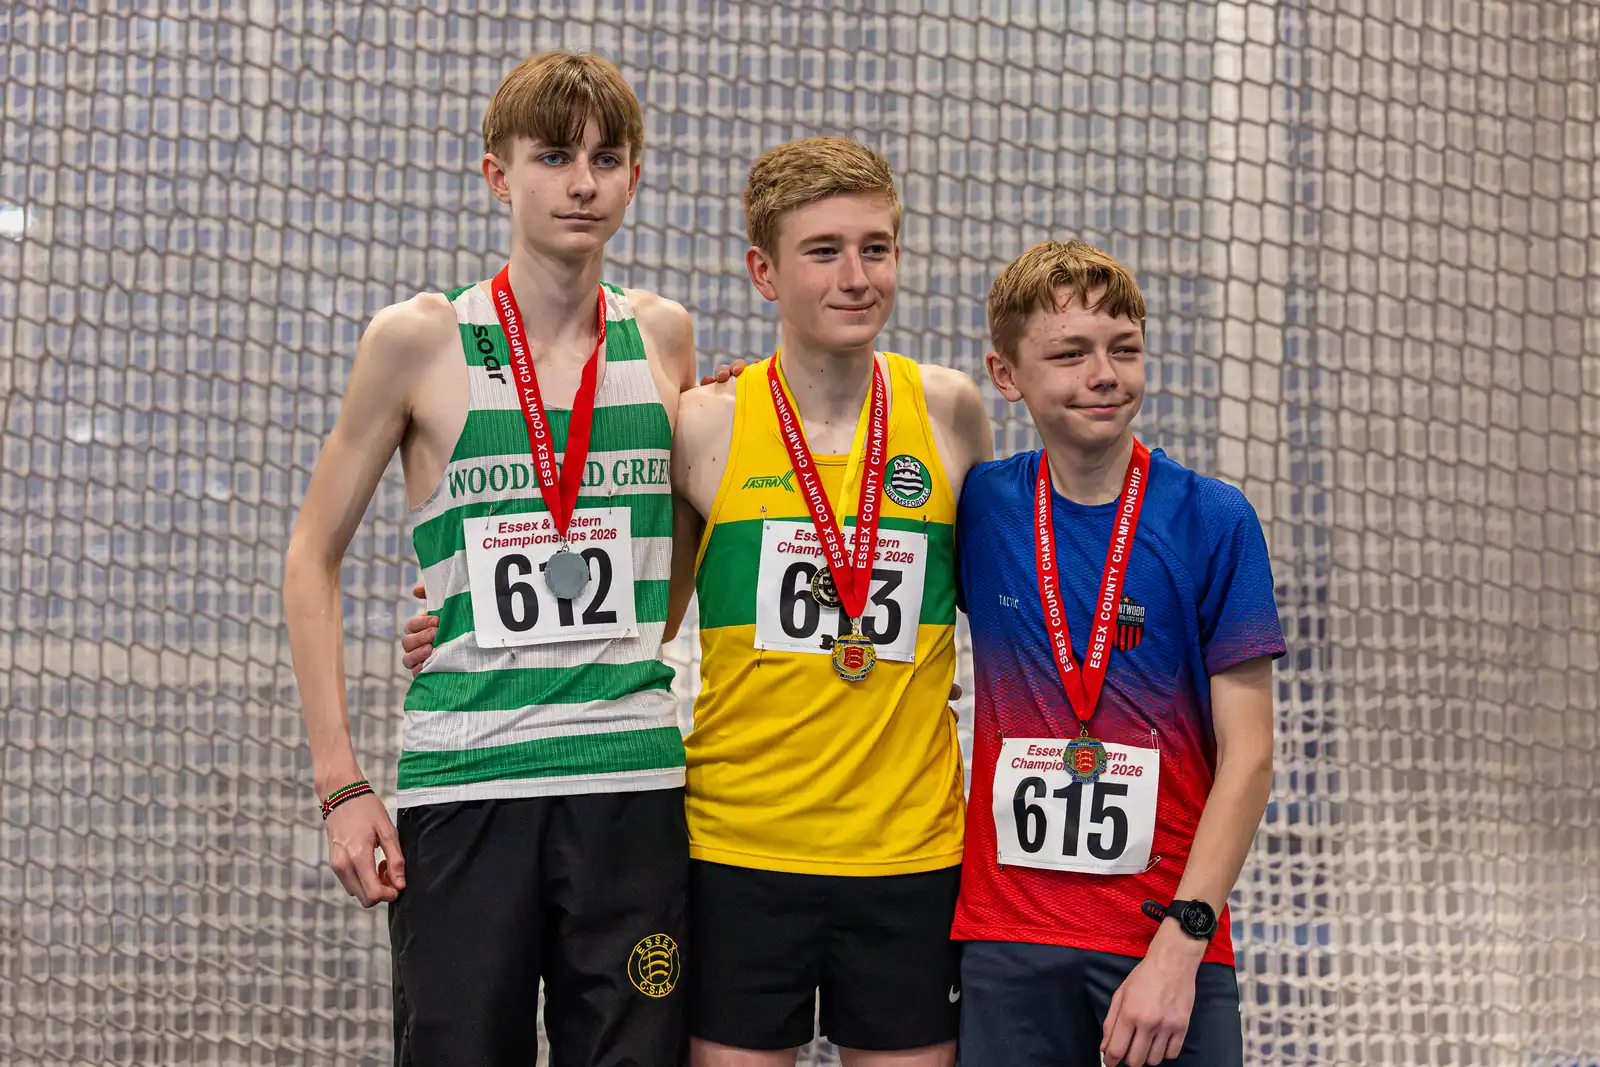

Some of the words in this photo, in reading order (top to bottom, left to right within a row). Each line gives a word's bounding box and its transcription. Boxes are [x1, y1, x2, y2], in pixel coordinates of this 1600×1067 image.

[472, 325, 507, 385] soar
[498, 290, 531, 383] CHAMPIONSHIP
[523, 387, 546, 439] COUNTY
[770, 379, 808, 468] CHAMPIONSHIP
[870, 372, 884, 465] CHAMPIONSHIP
[448, 461, 605, 498] WOODD
[537, 443, 554, 487] ESSEX
[802, 472, 829, 523] COUNTY
[862, 469, 879, 522] COUNTY
[498, 519, 538, 534] Essex
[541, 518, 551, 530] &
[553, 516, 601, 530] stern
[590, 528, 617, 541] 2026
[823, 525, 845, 569] ESSEX
[857, 526, 871, 569] ESSEX
[1038, 478, 1052, 571] CHAMPIONSHIP
[884, 550, 914, 564] 2026
[1089, 625, 1108, 669] ESSEX
[1100, 566, 1120, 621] COUNTY
[1112, 467, 1142, 563] CHAMPIONSHIP
[779, 561, 903, 646] 63
[1042, 575, 1061, 627] COUNTY
[1054, 630, 1074, 673] ESSEX
[1027, 745, 1063, 757] Essex
[1110, 763, 1144, 777] 2026
[1013, 776, 1129, 861] 615
[636, 935, 677, 955] ESSEX
